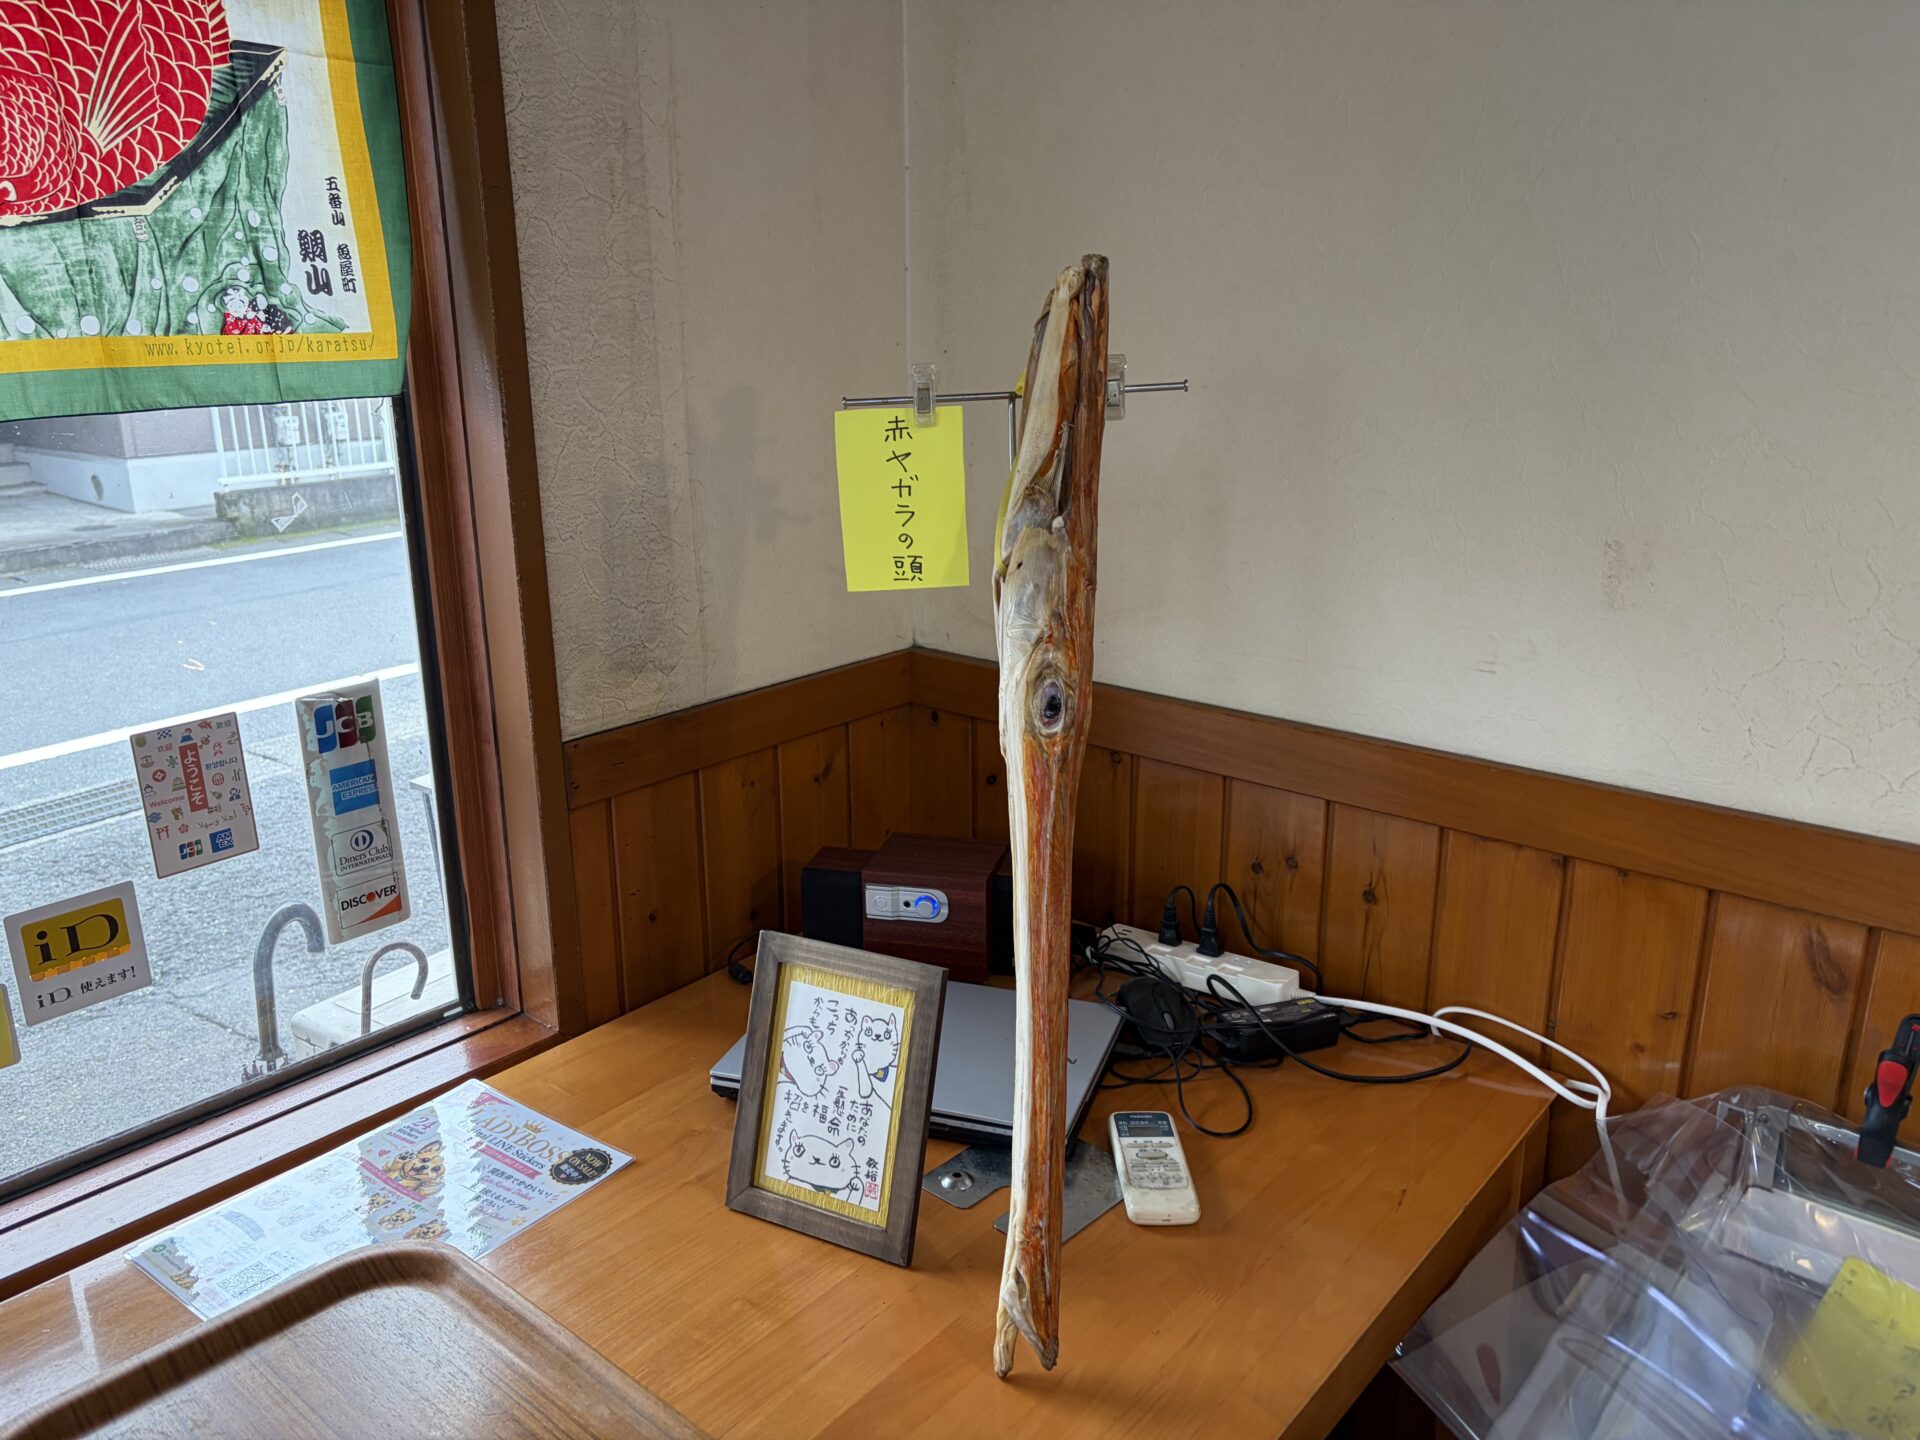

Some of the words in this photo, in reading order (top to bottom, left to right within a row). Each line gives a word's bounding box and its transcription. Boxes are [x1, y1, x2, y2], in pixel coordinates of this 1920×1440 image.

[324, 176, 345, 226] 五番山
[297, 229, 333, 296] 鯛山
[885, 415, 923, 582] 赤ヤガラの頭
[315, 706, 375, 743] JCB
[184, 750, 203, 805] ようこそ
[205, 757, 238, 771] 환영합니다
[332, 776, 375, 791] AMERICAN
[342, 784, 378, 800] EXPRESS
[149, 795, 184, 808] Welcome
[217, 832, 232, 842] AM
[219, 839, 234, 848] EX
[340, 853, 367, 866] Diners
[369, 845, 388, 857] Club
[340, 853, 391, 872] INTERNATIONAL
[341, 885, 397, 911] DISCOVER
[34, 914, 119, 966] iD
[809, 996, 824, 1029] からも
[827, 1000, 839, 1036] こっち
[411, 1115, 439, 1131] 24
[827, 1085, 848, 1137] 一生懸命
[846, 1099, 860, 1132] ために
[857, 1100, 873, 1146] あなたの
[488, 1136, 516, 1153] LINE
[512, 1148, 546, 1170] Stickers
[568, 1156, 581, 1166] ON
[585, 1153, 604, 1167] NOW
